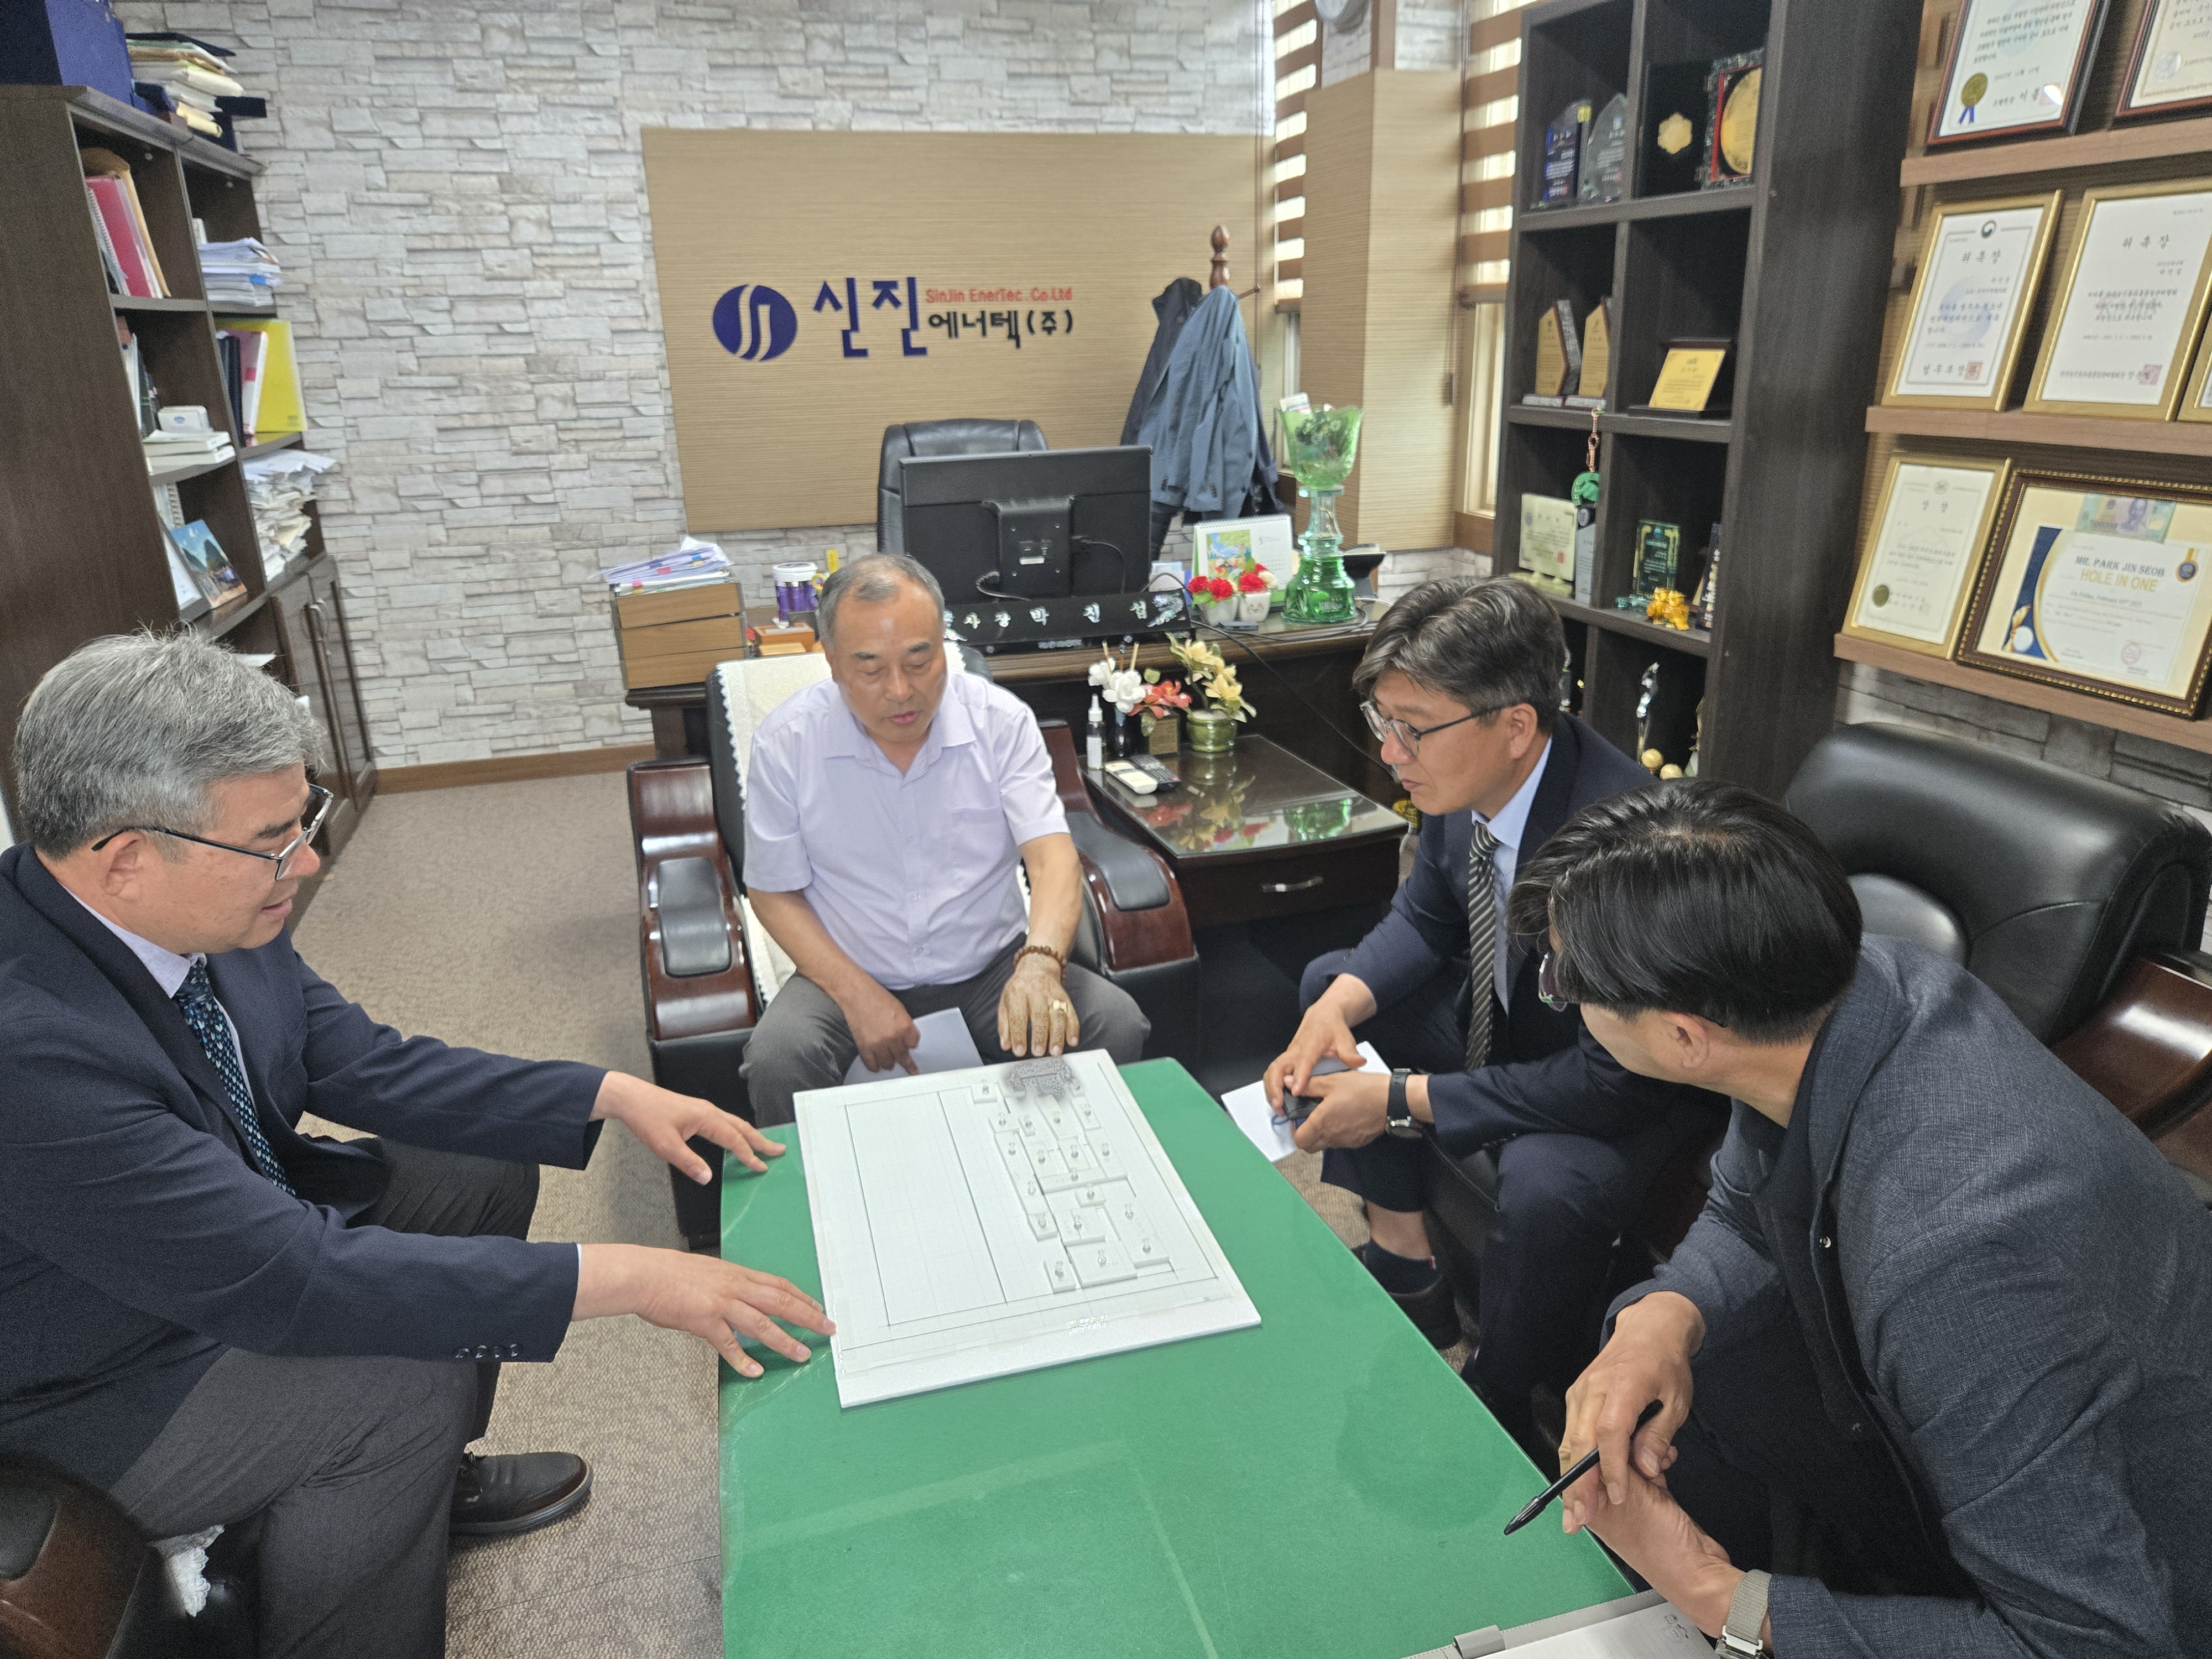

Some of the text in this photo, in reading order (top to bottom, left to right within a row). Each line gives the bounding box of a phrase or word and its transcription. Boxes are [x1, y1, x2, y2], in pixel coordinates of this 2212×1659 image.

[813, 276, 928, 358] 신진
[2093, 559, 2120, 570] PARK
[2122, 562, 2137, 574] JIN
[2080, 568, 2158, 593] HOLE IN ONE
